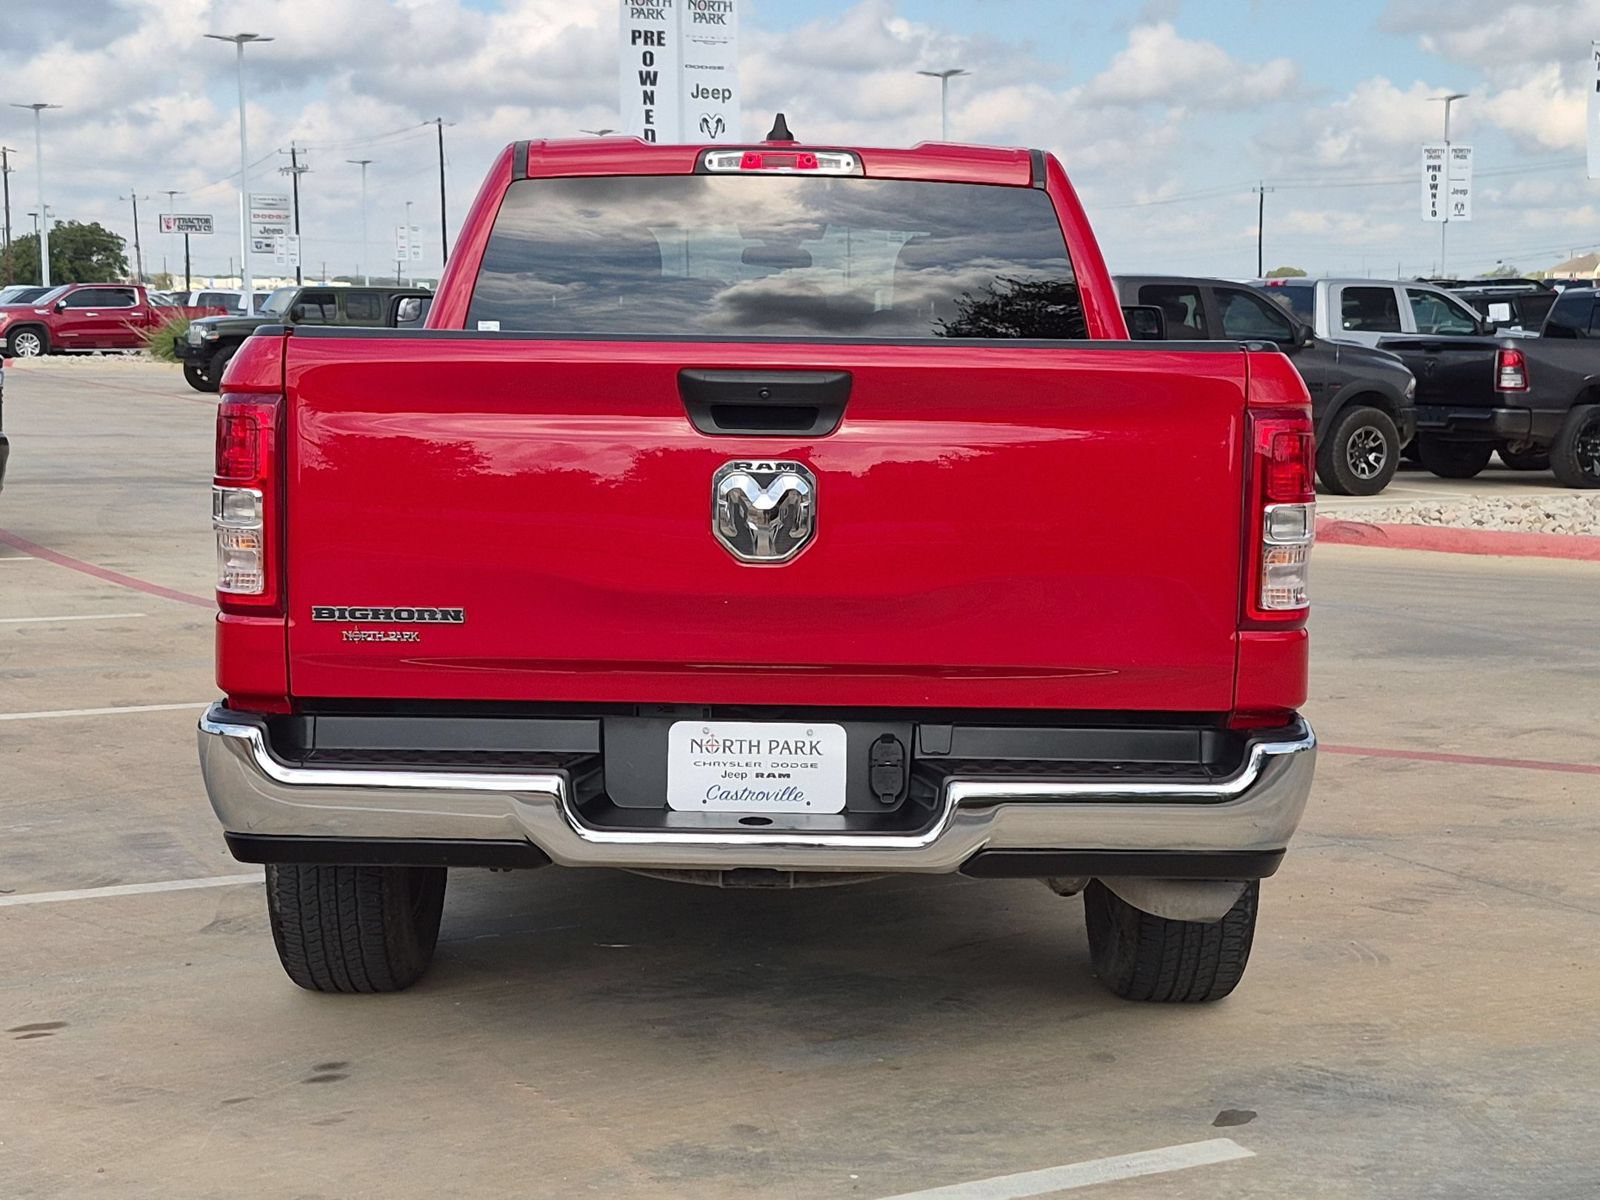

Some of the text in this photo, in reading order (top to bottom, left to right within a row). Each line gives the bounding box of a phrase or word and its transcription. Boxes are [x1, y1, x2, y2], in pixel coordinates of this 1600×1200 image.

[688, 1, 732, 12] NORTH
[630, 7, 665, 20] PARK
[693, 12, 726, 25] PARK
[631, 29, 666, 47] PRE
[691, 83, 732, 103] Jeep
[1427, 164, 1442, 173] PRE
[1429, 173, 1439, 218] OWNED
[1451, 188, 1468, 196] Jeep
[259, 226, 284, 235] Jeep
[733, 461, 796, 472] RAM
[311, 605, 465, 624] BIGHORN
[341, 629, 421, 643] NORTH PARK
[690, 737, 824, 757] NORTH PARK
[693, 760, 819, 770] CHRYSLER DODGE
[721, 770, 792, 781] Jeep RAM
[705, 784, 805, 802] Castroville
